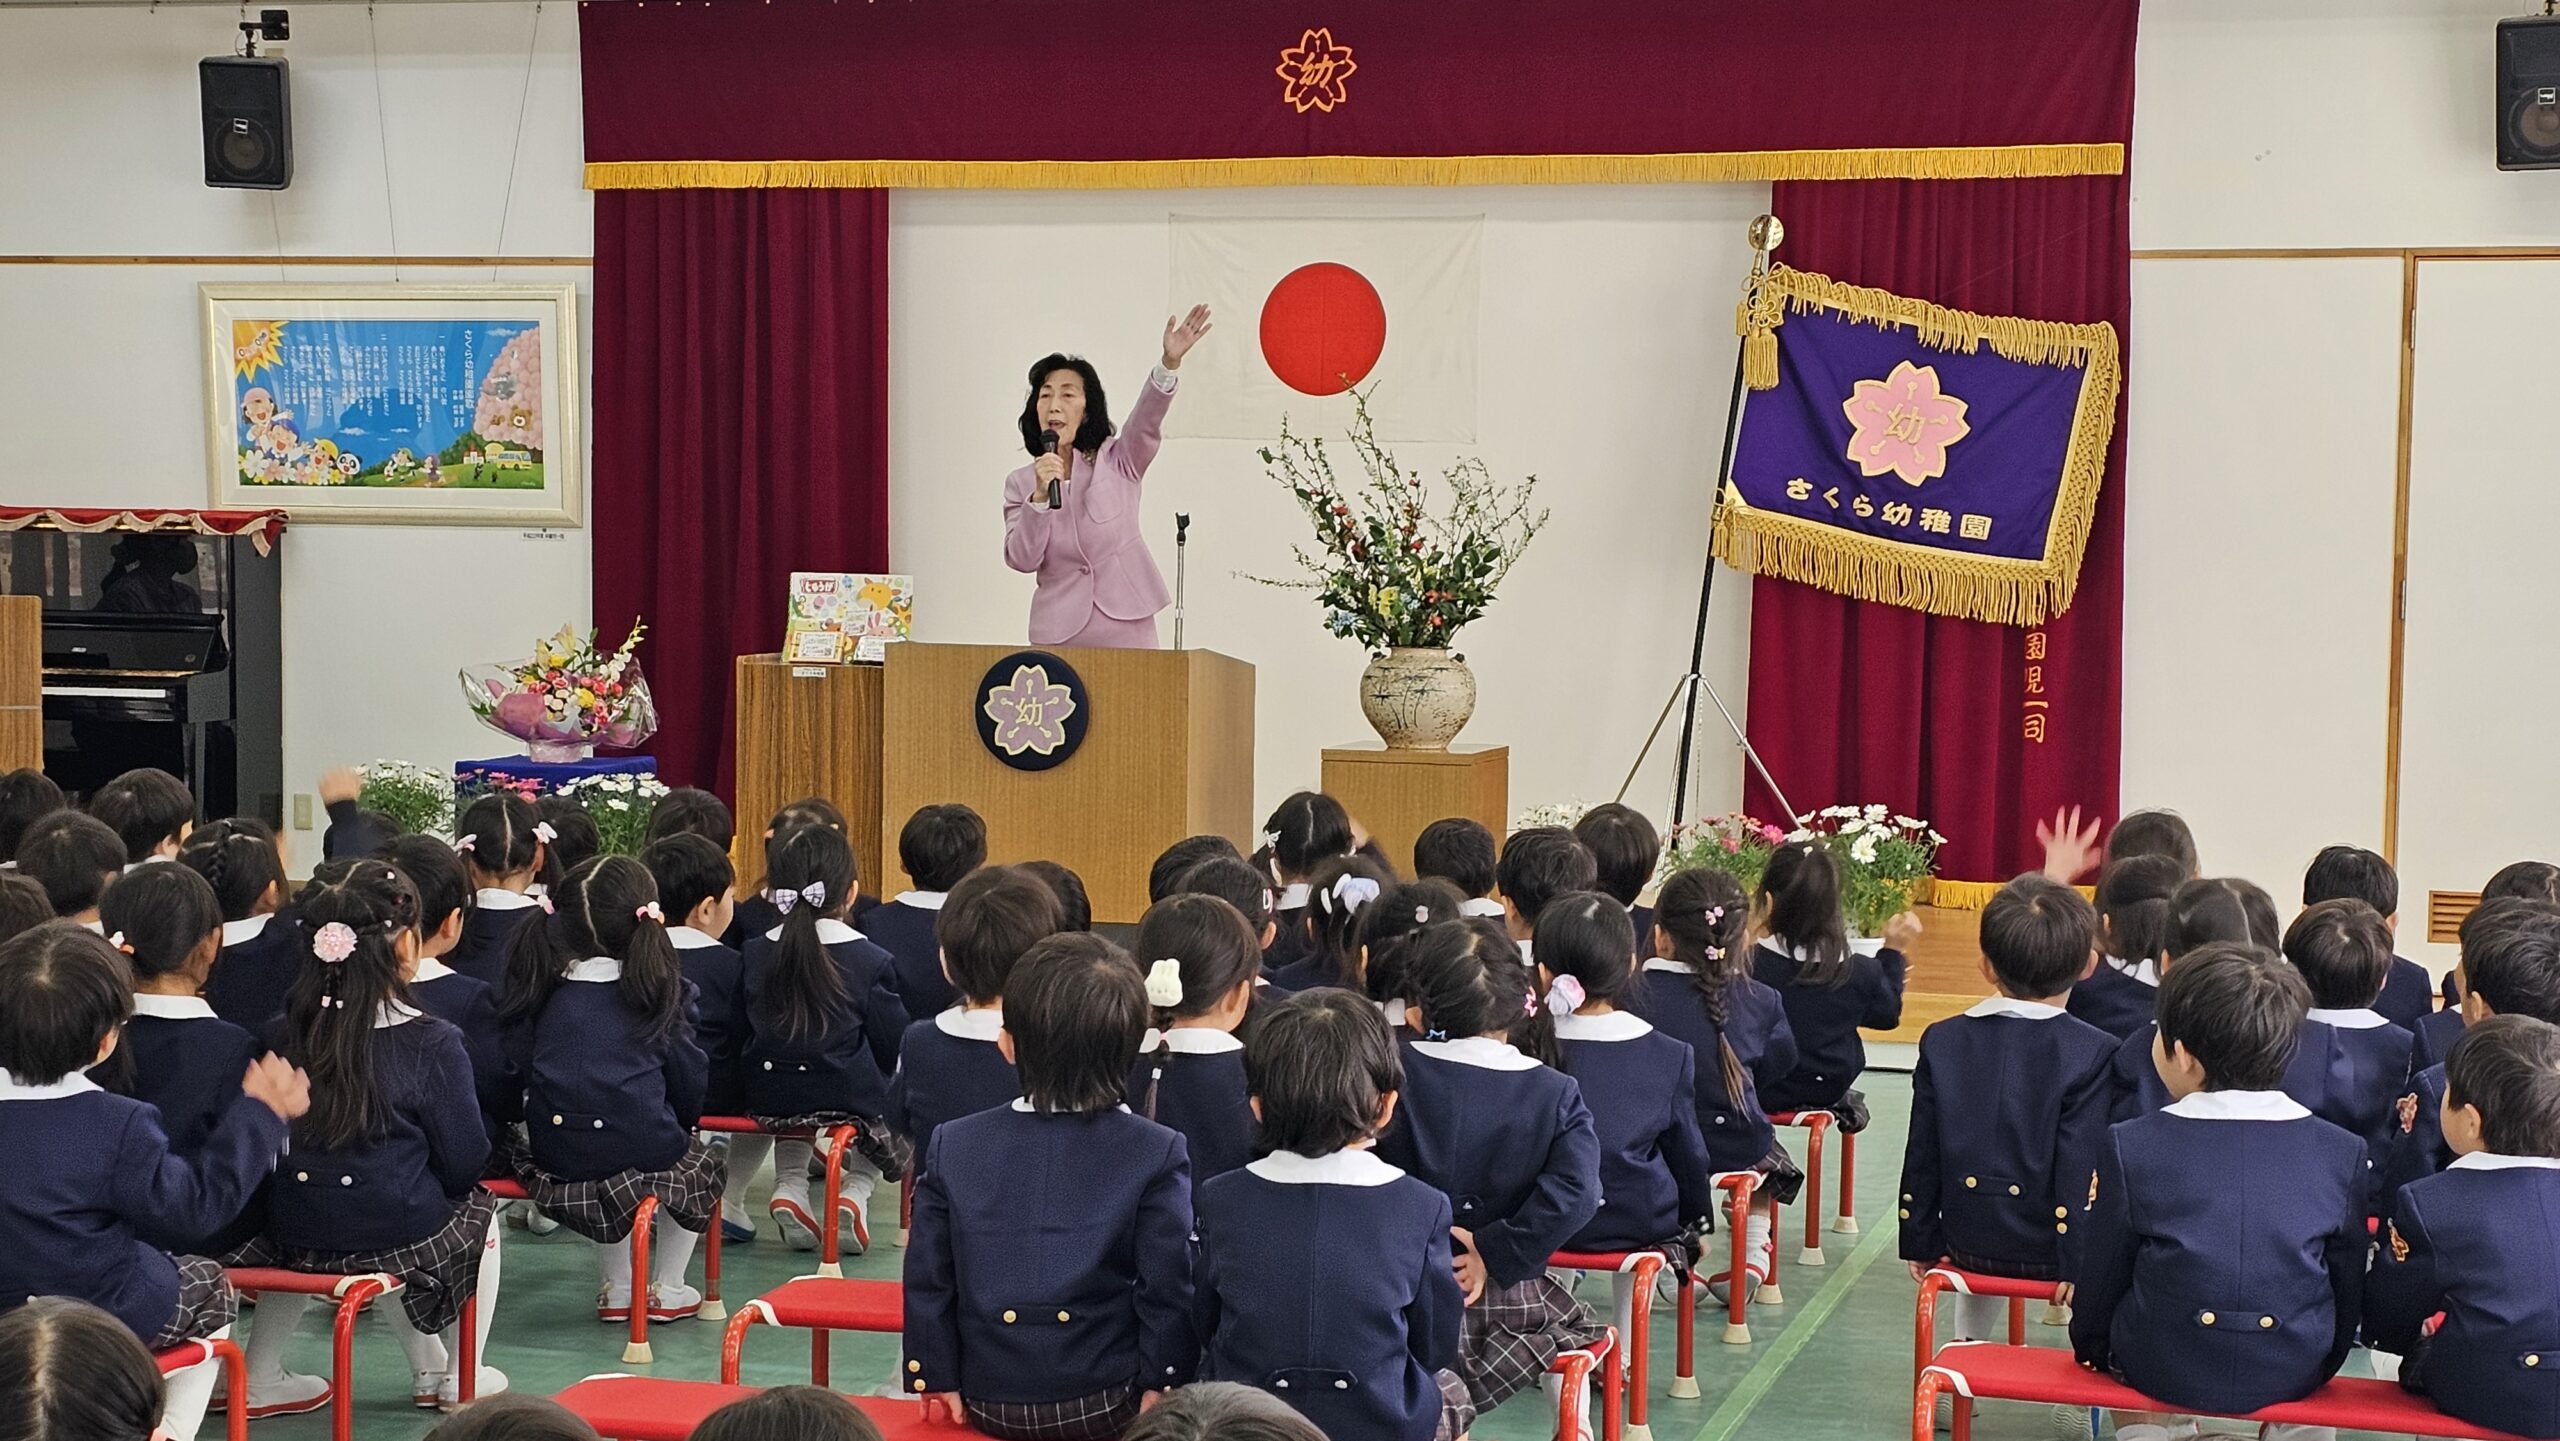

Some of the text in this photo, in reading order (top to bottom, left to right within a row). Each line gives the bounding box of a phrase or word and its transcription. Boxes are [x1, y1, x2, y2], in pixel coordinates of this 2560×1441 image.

[1299, 51, 1335, 89] 幼
[1883, 402, 1926, 446] 幼
[1786, 477, 1993, 541] さくら幼稚園
[1015, 697, 1043, 727] 幼
